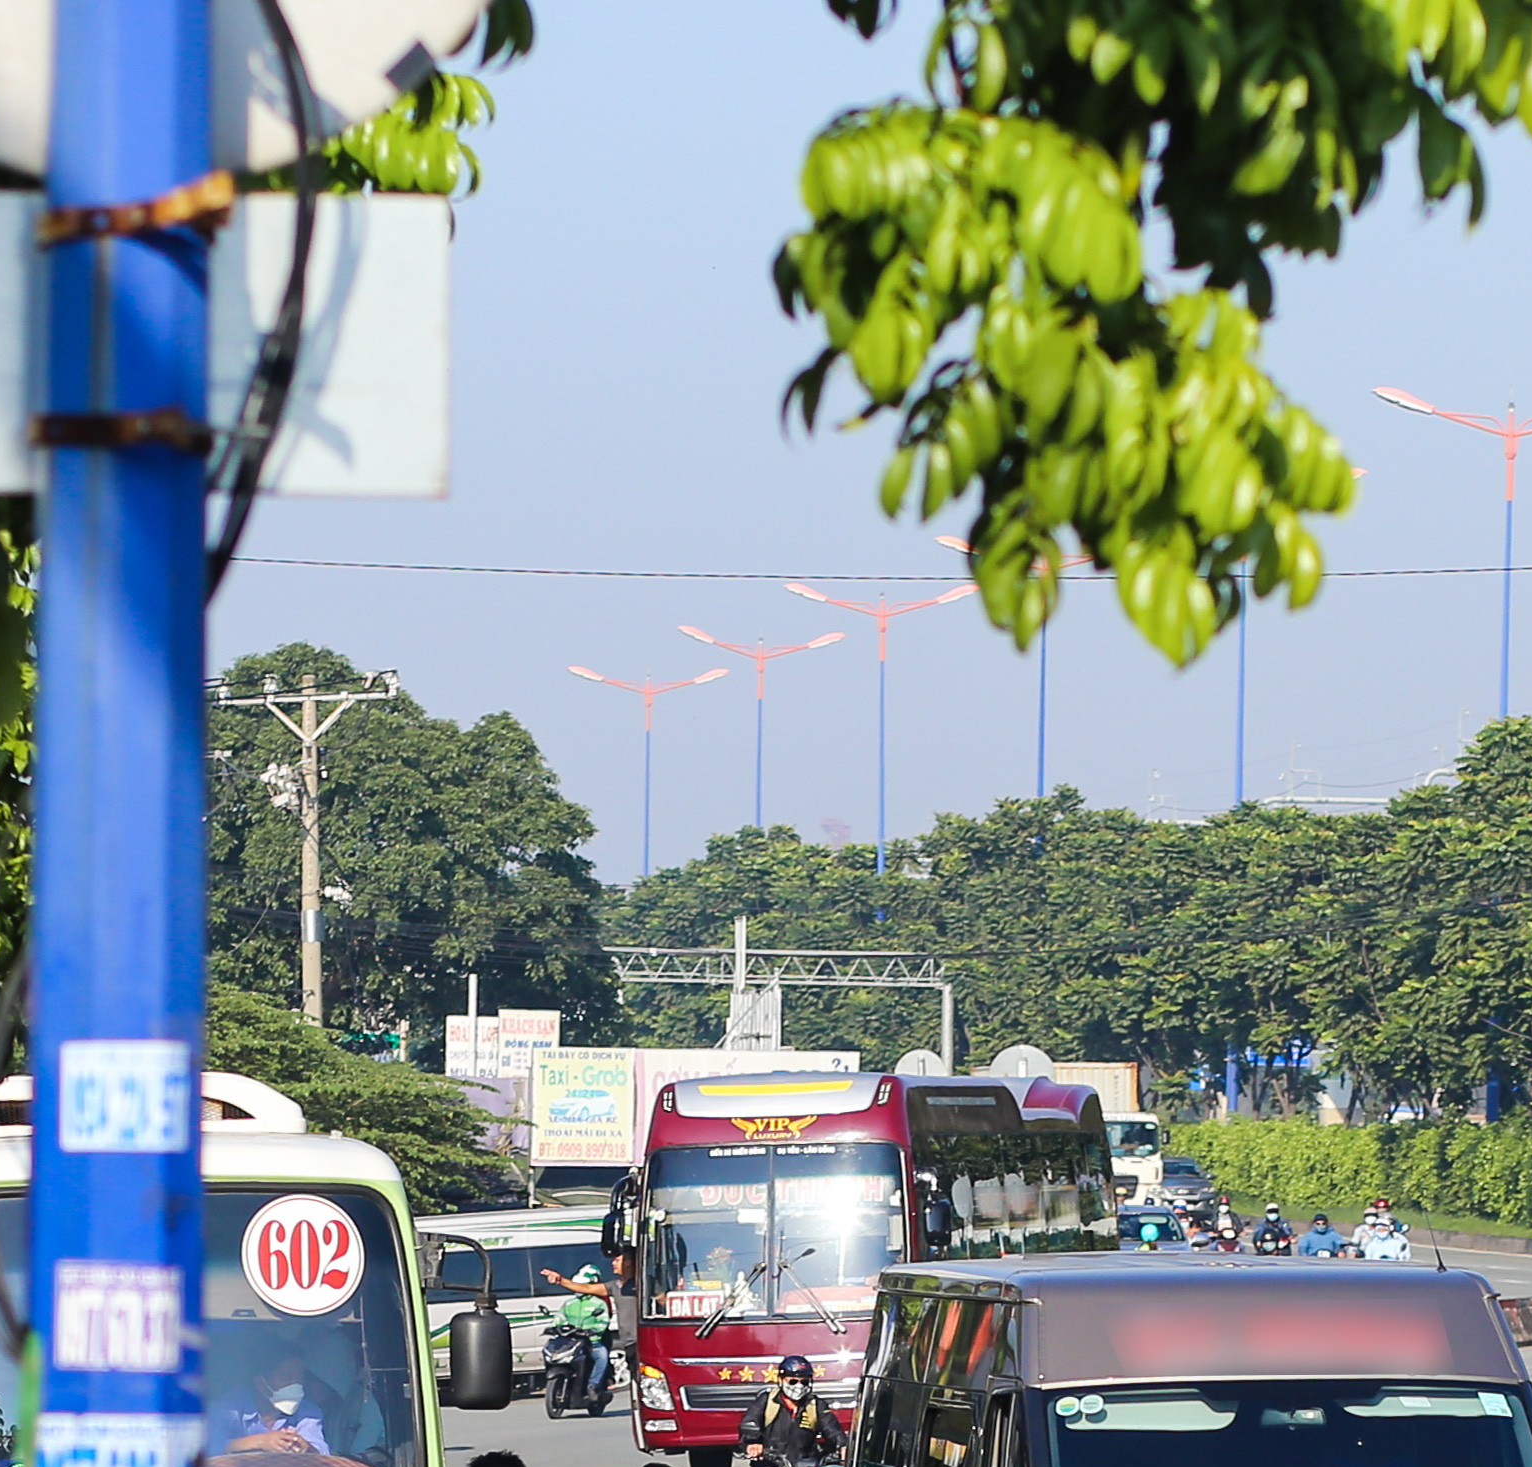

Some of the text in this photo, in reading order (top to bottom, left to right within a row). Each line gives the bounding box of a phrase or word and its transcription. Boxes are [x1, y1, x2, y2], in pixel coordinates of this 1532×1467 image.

[539, 1064, 569, 1086] Taxi
[582, 1064, 627, 1086] Grab
[753, 1117, 791, 1132] VIP
[753, 1132, 793, 1140] LUXURY
[258, 1216, 351, 1292] 602
[671, 1295, 719, 1319] ĐÀ LẠT
